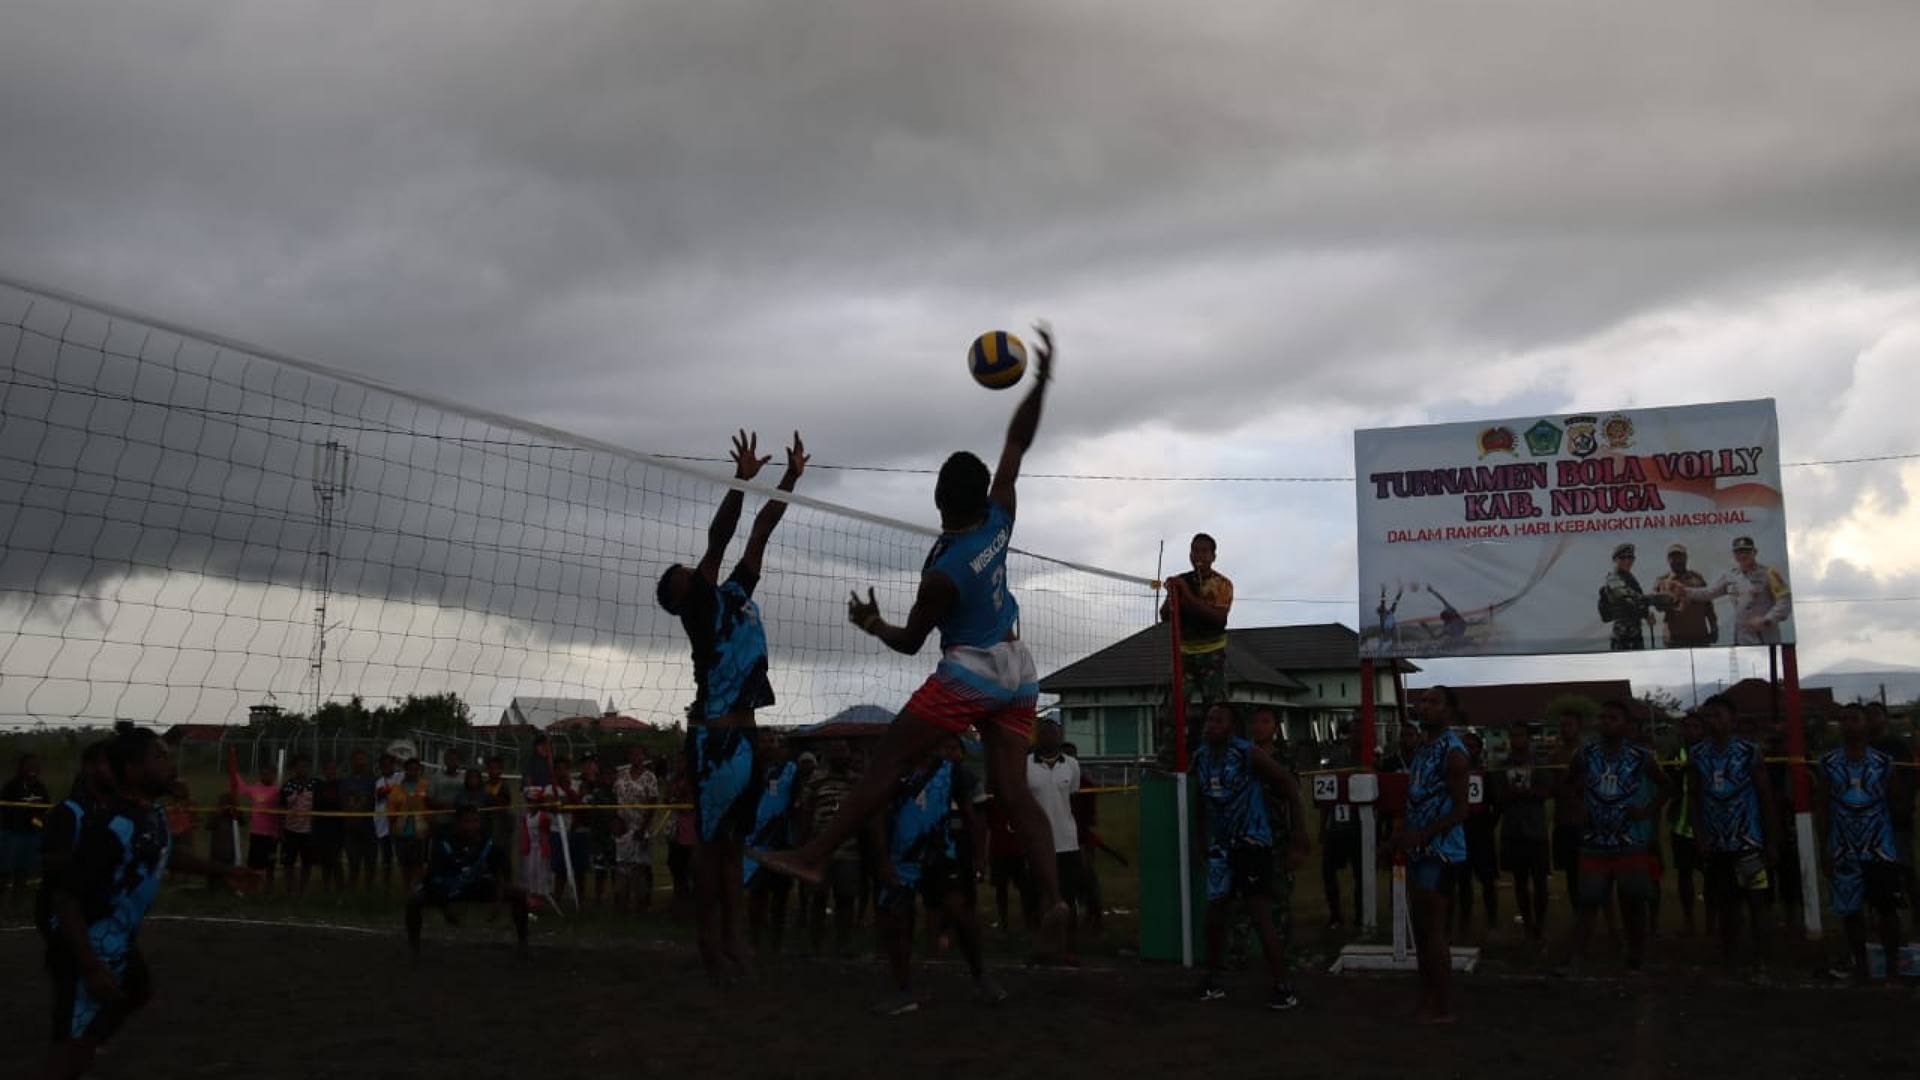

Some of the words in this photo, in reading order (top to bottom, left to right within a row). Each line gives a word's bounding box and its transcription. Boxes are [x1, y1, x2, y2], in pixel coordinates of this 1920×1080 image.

[1370, 461, 1548, 499] TURNAMEN
[1556, 455, 1646, 487] BOLA
[1653, 446, 1762, 481] VOLLY
[1464, 492, 1542, 521] KAB.
[1550, 483, 1664, 516] NDUGA
[1387, 529, 1442, 543] DALAM
[1445, 523, 1509, 540] RANGKA
[1514, 521, 1551, 535] HARI
[1554, 515, 1666, 533] KEBANGKITAN
[1669, 510, 1752, 527] NASIONAL
[1316, 780, 1334, 796] 24
